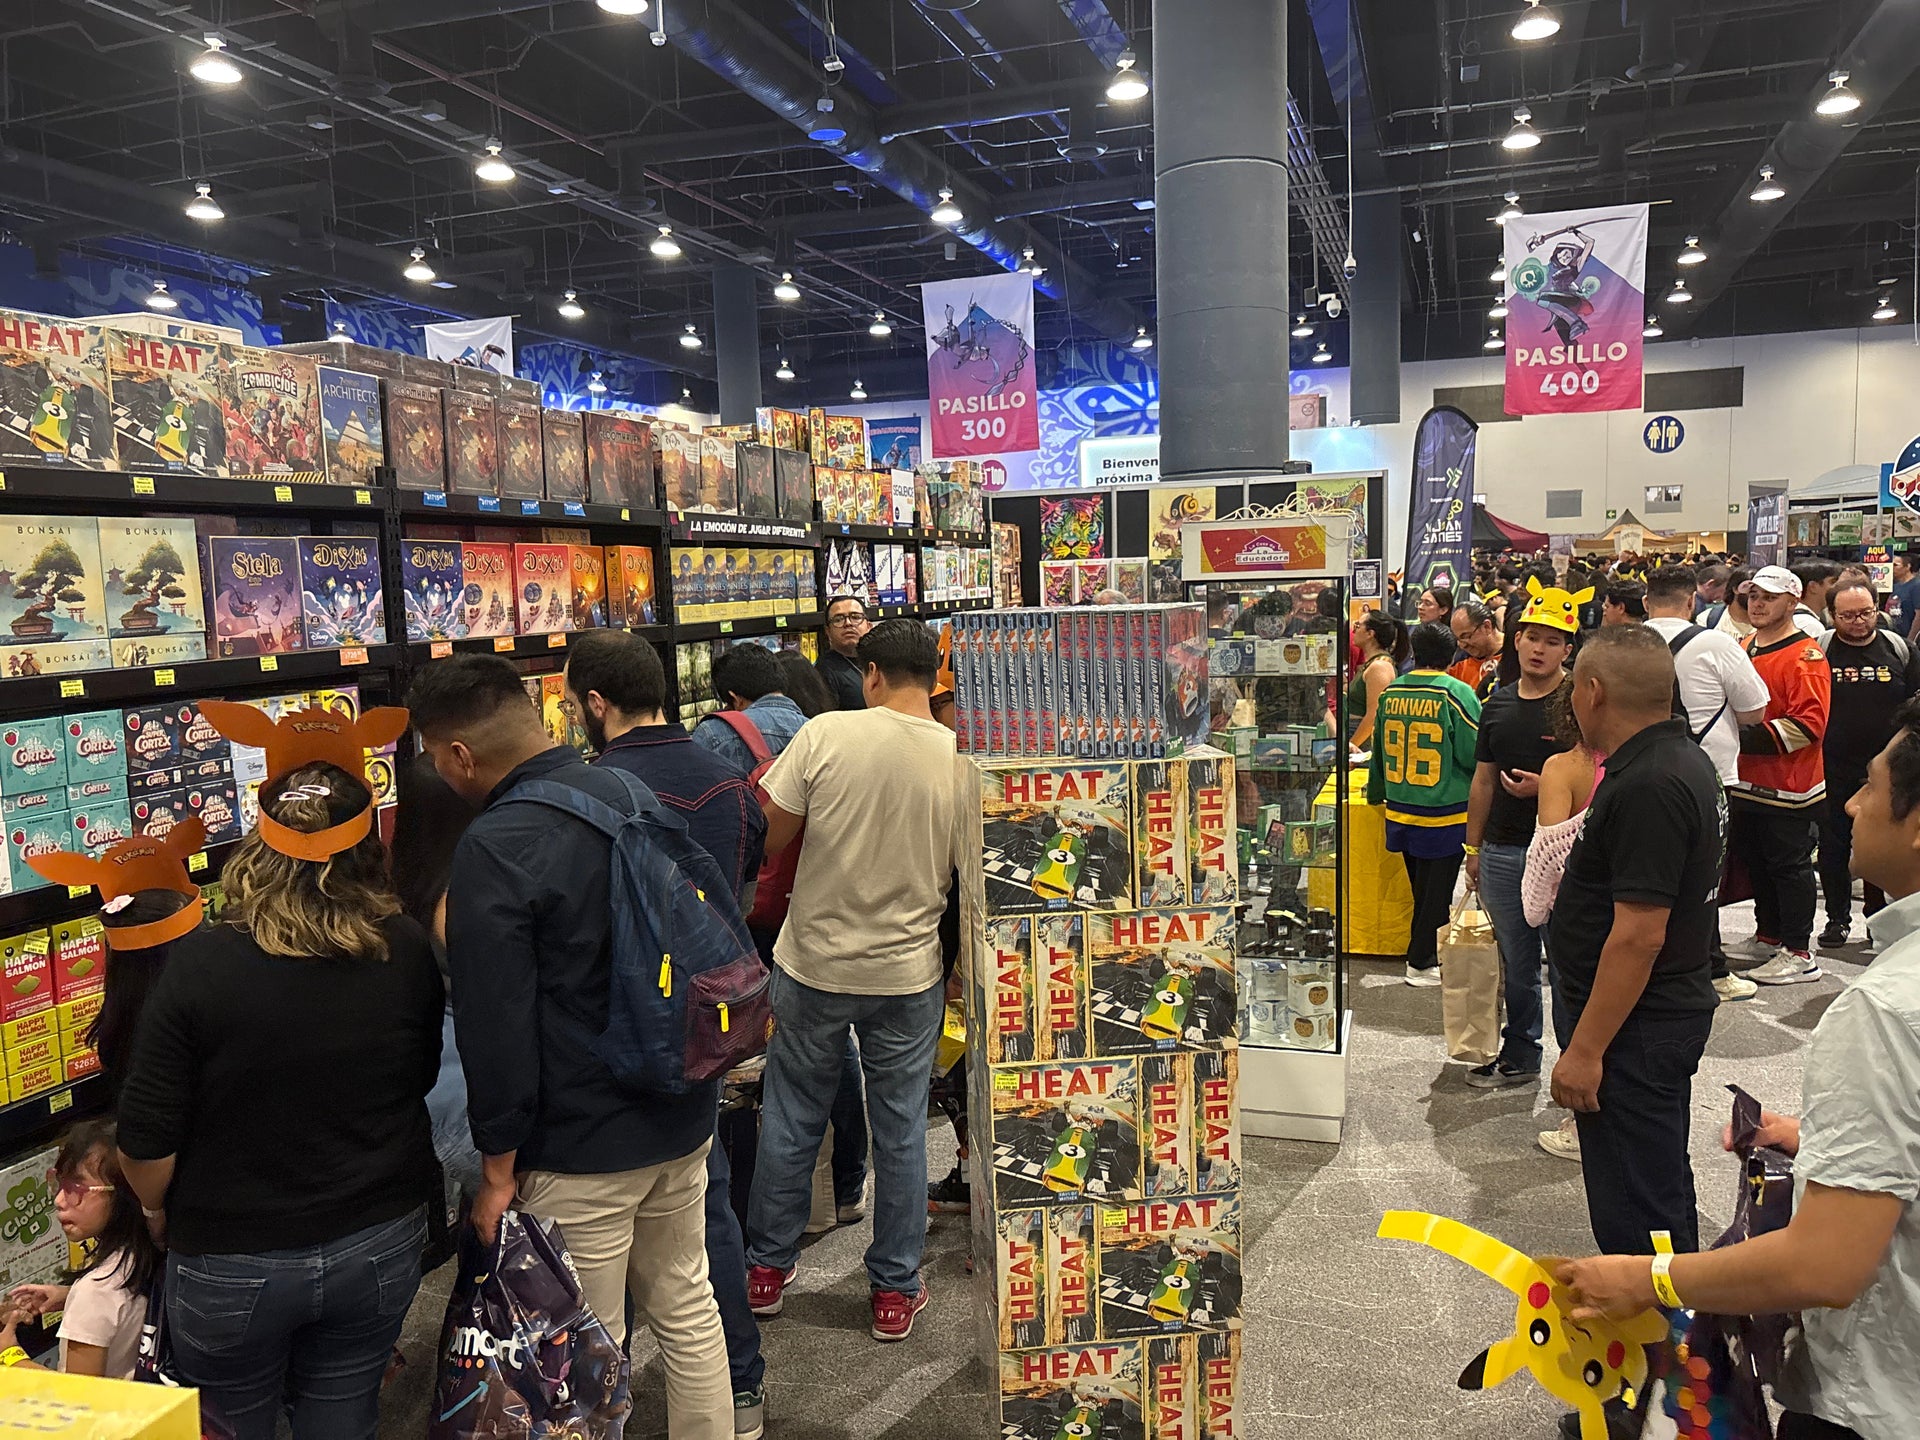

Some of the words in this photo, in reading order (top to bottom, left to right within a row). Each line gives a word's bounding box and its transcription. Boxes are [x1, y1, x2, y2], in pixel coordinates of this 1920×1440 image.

[0, 317, 85, 357] HEAT
[128, 339, 202, 375] HEAT
[1514, 341, 1628, 368] PASILLO
[242, 371, 298, 400] ZOMBICIDE
[323, 383, 377, 404] ARCHITECTS
[1539, 370, 1600, 397] 400
[49, 403, 61, 417] 3
[938, 390, 1026, 417] PASILLO
[170, 415, 181, 428] 3
[961, 416, 1006, 441] 300
[1103, 459, 1158, 469] Bienven
[1096, 473, 1153, 487] próxima
[893, 485, 914, 498] SEQUENCE
[17, 526, 72, 535] BONSAI
[125, 528, 173, 537] BONSAI
[690, 521, 702, 532] LA
[703, 520, 735, 534] EMOCIÓN
[737, 523, 748, 534] DE
[748, 525, 771, 535] JUGAR
[771, 526, 806, 538] DIFERENTE
[232, 551, 282, 580] Stella
[1864, 554, 1879, 563] HAY
[310, 631, 329, 642] Disney
[1060, 616, 1072, 660] HEAT
[1077, 616, 1090, 660] HEAT
[1095, 616, 1108, 660] HEAT
[1113, 616, 1126, 660] HEAT
[1131, 615, 1144, 660] HEAT
[1149, 614, 1162, 660] HEAT
[46, 653, 91, 664] BONSAI
[150, 645, 190, 655] BONSAI
[1385, 697, 1442, 719] CONWAY
[145, 730, 166, 739] SUPER
[185, 727, 221, 743] CORTEX
[956, 709, 969, 750] HEAT
[973, 708, 986, 750] HEAT
[990, 708, 1003, 750] HEAT
[1008, 708, 1020, 750] HEAT
[1025, 709, 1037, 751] HEAT
[1041, 709, 1055, 752] HEAT
[77, 738, 118, 757] CORTEX
[134, 735, 171, 753] CORTEX
[1384, 720, 1443, 787] 96
[12, 747, 57, 767] CORTEX
[198, 764, 220, 776] CORTEX
[82, 781, 112, 796] CORTEX
[146, 775, 170, 787] CORTEX
[1004, 771, 1103, 803] HEAT
[17, 794, 48, 808] CORTEX
[199, 808, 233, 826] CORTEX
[83, 828, 125, 848] CORTEX
[1148, 791, 1173, 875] HEAT
[1200, 789, 1225, 872] HEAT
[20, 841, 63, 861] CORTEX
[1054, 850, 1068, 863] 3
[1112, 913, 1211, 946] HEAT
[60, 934, 98, 951] HAPPY
[60, 943, 100, 961] SALMON
[5, 960, 46, 978] SALMON
[997, 949, 1023, 1033] HEAT
[1050, 946, 1075, 1029] HEAT
[1162, 991, 1176, 1004] 3
[72, 999, 99, 1013] HAPPY
[16, 1015, 46, 1032] HAPPY
[17, 1023, 47, 1038] SALMON
[19, 1041, 49, 1057] HAPPY
[20, 1049, 50, 1064] SALMON
[74, 1058, 95, 1070] $265
[22, 1067, 51, 1082] HAPPY
[23, 1074, 52, 1090] SALMON
[1015, 1066, 1113, 1100] HEAT
[1153, 1084, 1178, 1165] HEAT
[1205, 1080, 1230, 1161] HEAT
[1065, 1145, 1078, 1157] 3
[14, 1192, 35, 1211] So
[3, 1193, 53, 1238] Clover!
[1122, 1200, 1218, 1233] HEAT
[1009, 1241, 1034, 1320] HEAT
[1060, 1236, 1086, 1316] HEAT
[1171, 1276, 1184, 1288] 3
[1023, 1347, 1119, 1382] HEAT
[1159, 1364, 1183, 1440] HEAT
[1208, 1359, 1233, 1437] HEAT
[1074, 1423, 1085, 1436] 3
